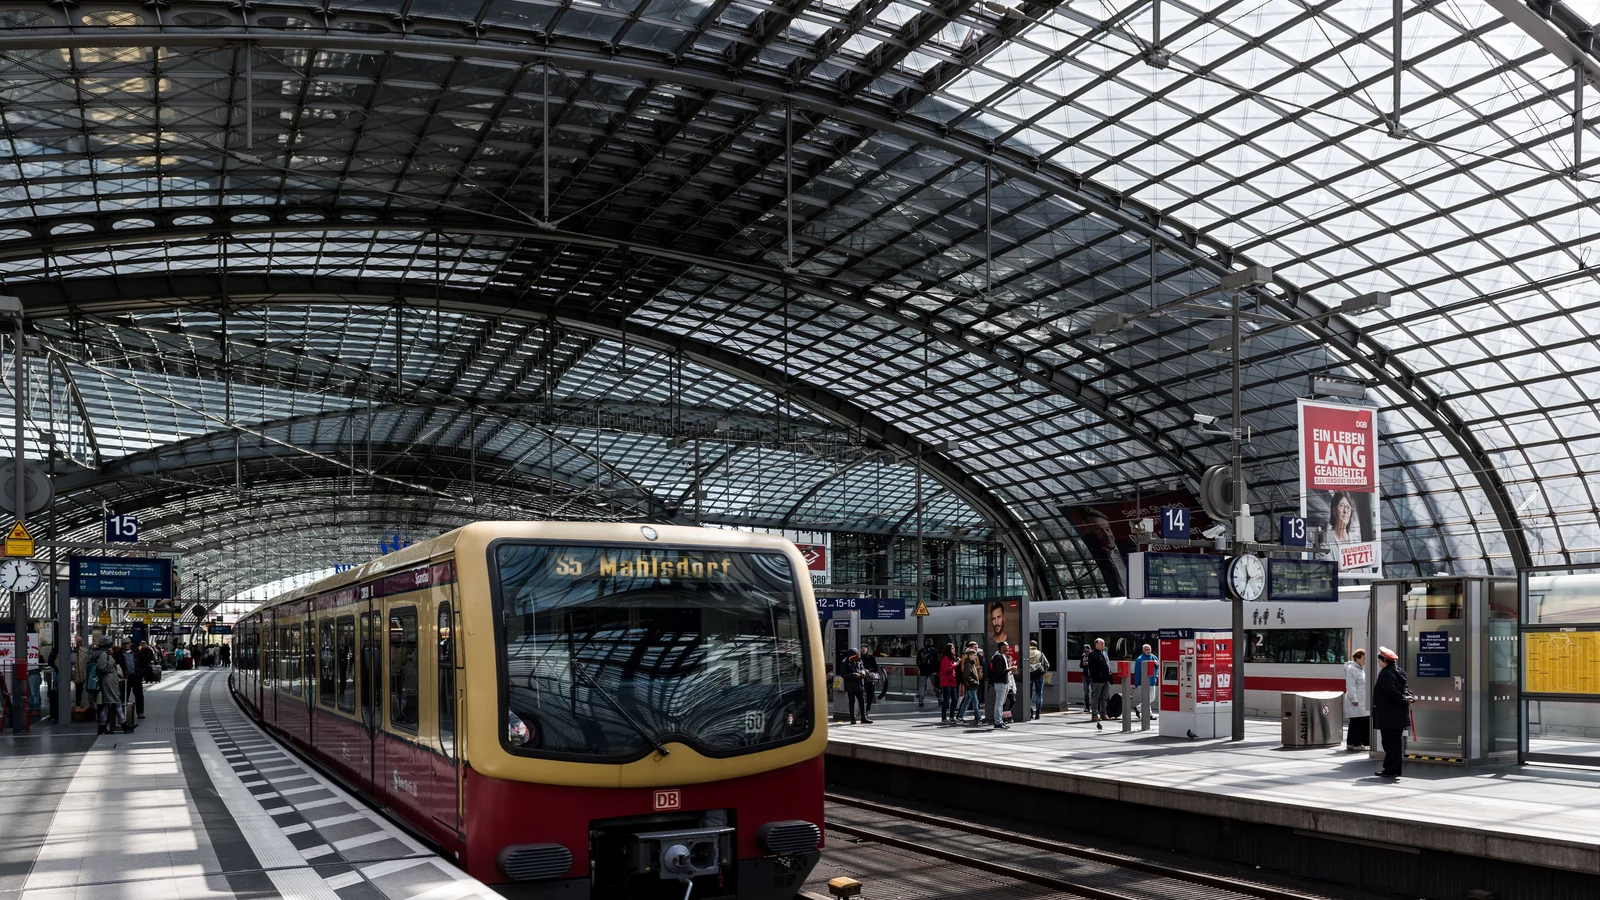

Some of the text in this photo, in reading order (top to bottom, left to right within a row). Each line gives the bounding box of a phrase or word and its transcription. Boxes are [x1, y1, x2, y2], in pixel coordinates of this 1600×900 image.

[1313, 428, 1365, 445] EIN LEBEN
[1313, 442, 1366, 468] LANG
[1121, 507, 1149, 518] Sieben
[1165, 509, 1185, 531] 14
[110, 516, 137, 536] 15
[1288, 518, 1305, 539] 13
[1341, 544, 1372, 554] GRUNDRENTE
[556, 554, 732, 578] S5 Mahlsdorf
[1342, 550, 1373, 567] JETZT!
[835, 598, 856, 608] 15-16
[1255, 633, 1264, 647] 2
[656, 791, 678, 808] DB
